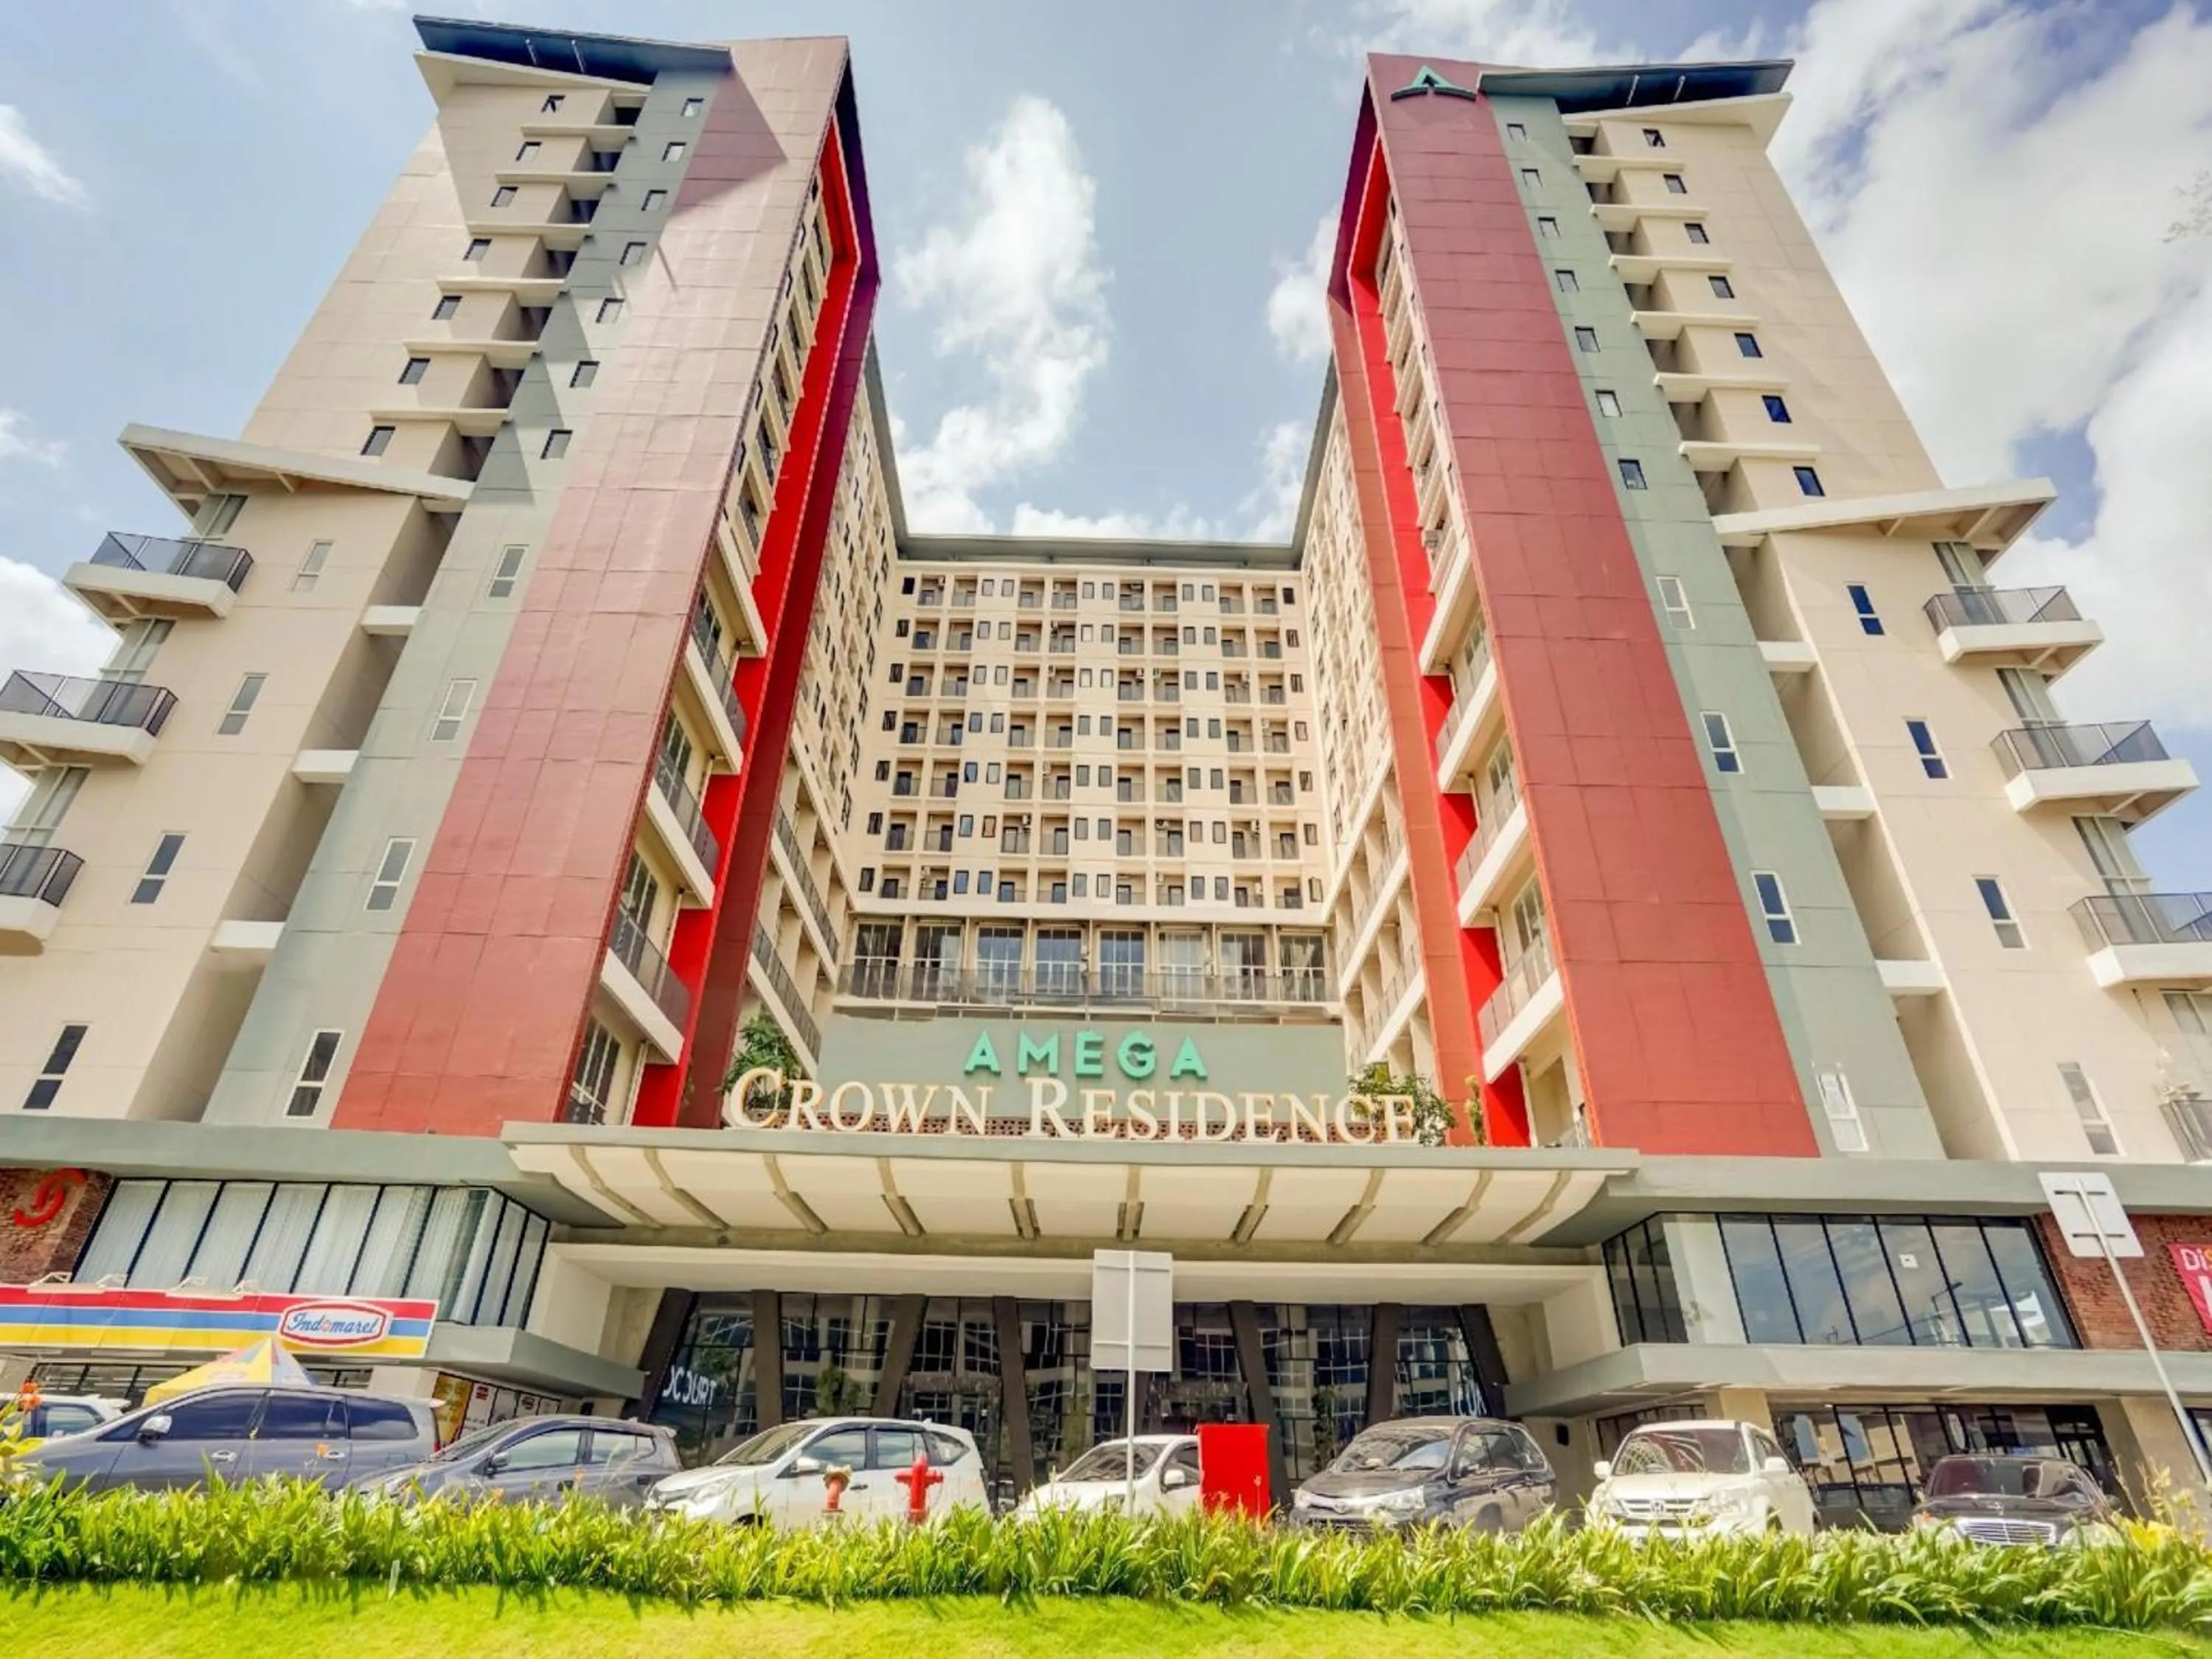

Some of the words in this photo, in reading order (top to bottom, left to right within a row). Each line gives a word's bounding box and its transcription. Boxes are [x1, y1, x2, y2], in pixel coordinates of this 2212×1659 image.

[963, 1030, 1208, 1080] AMEGA
[728, 1067, 995, 1135] CROWN
[1023, 1077, 1423, 1145] RESIDENCE
[287, 1312, 380, 1333] Indomaret
